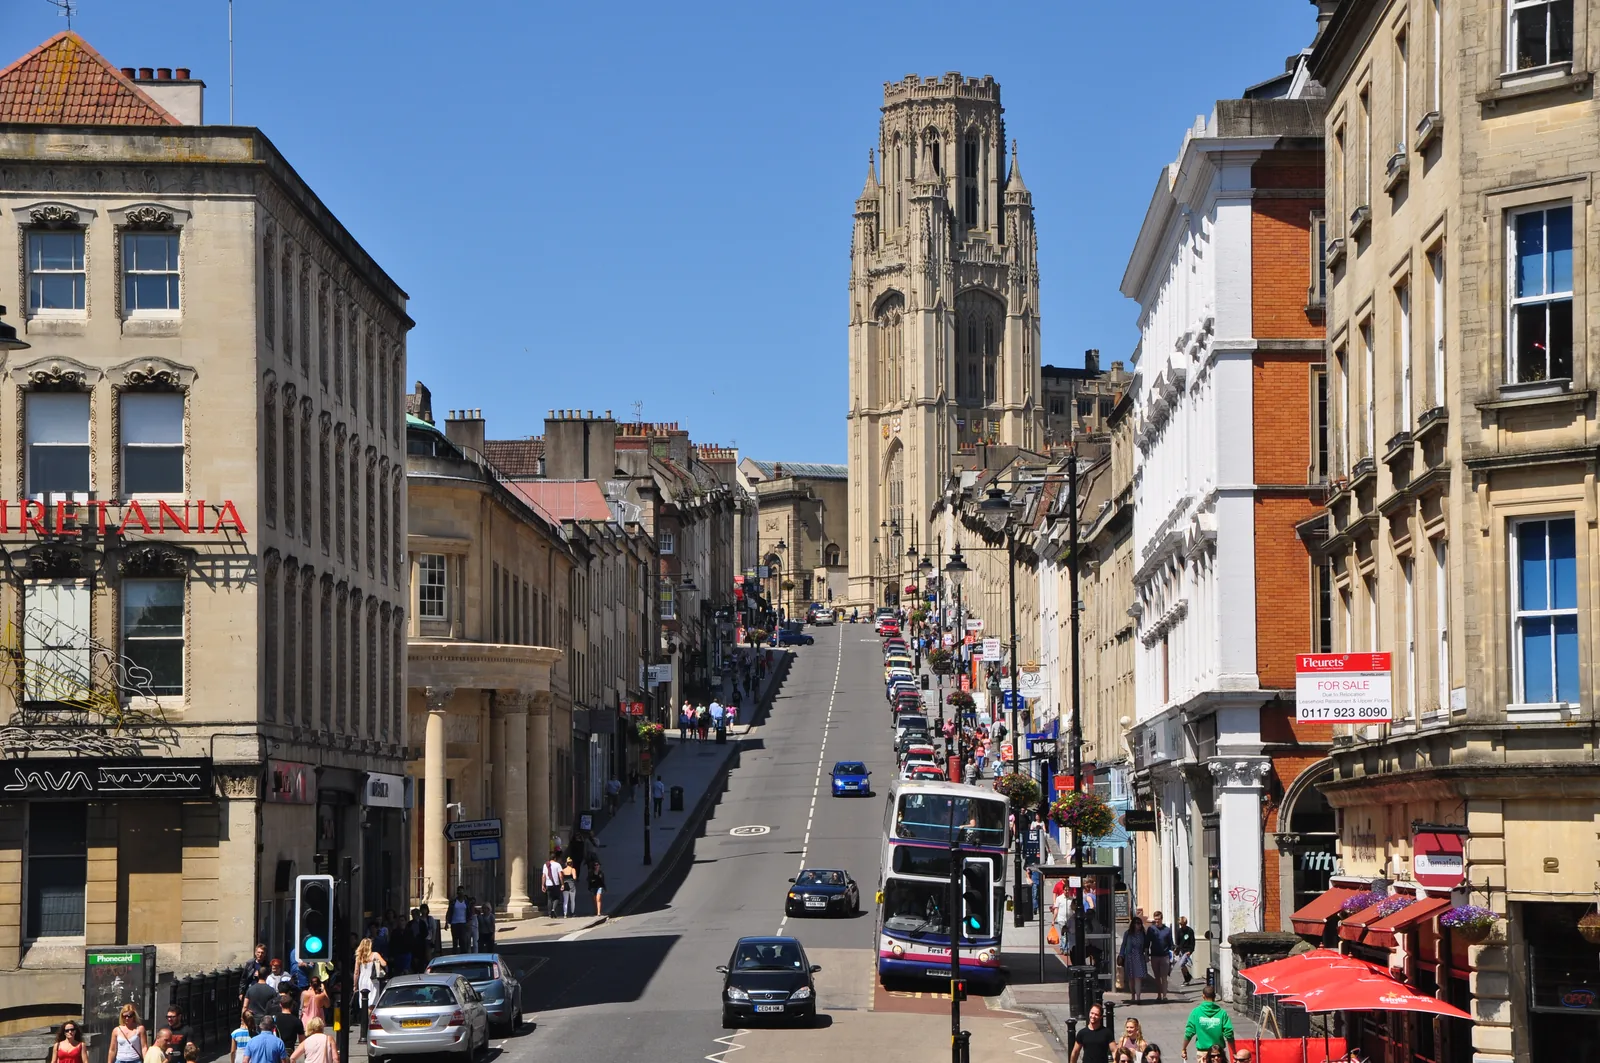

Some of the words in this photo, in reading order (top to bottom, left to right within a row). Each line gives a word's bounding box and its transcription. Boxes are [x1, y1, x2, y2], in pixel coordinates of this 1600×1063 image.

[1303, 657, 1344, 668] Fleurets
[1318, 681, 1340, 691] FOR
[1342, 680, 1370, 690] SALE
[1301, 708, 1330, 718] 0117
[1333, 707, 1356, 718] 923
[1358, 707, 1388, 717] 8090
[1300, 851, 1338, 875] fifty
[1416, 858, 1425, 867] La
[1426, 858, 1461, 868] Tomatina
[1543, 857, 1560, 873] 2
[96, 954, 133, 963] Phonecard
[1563, 993, 1593, 1005] OPEN
